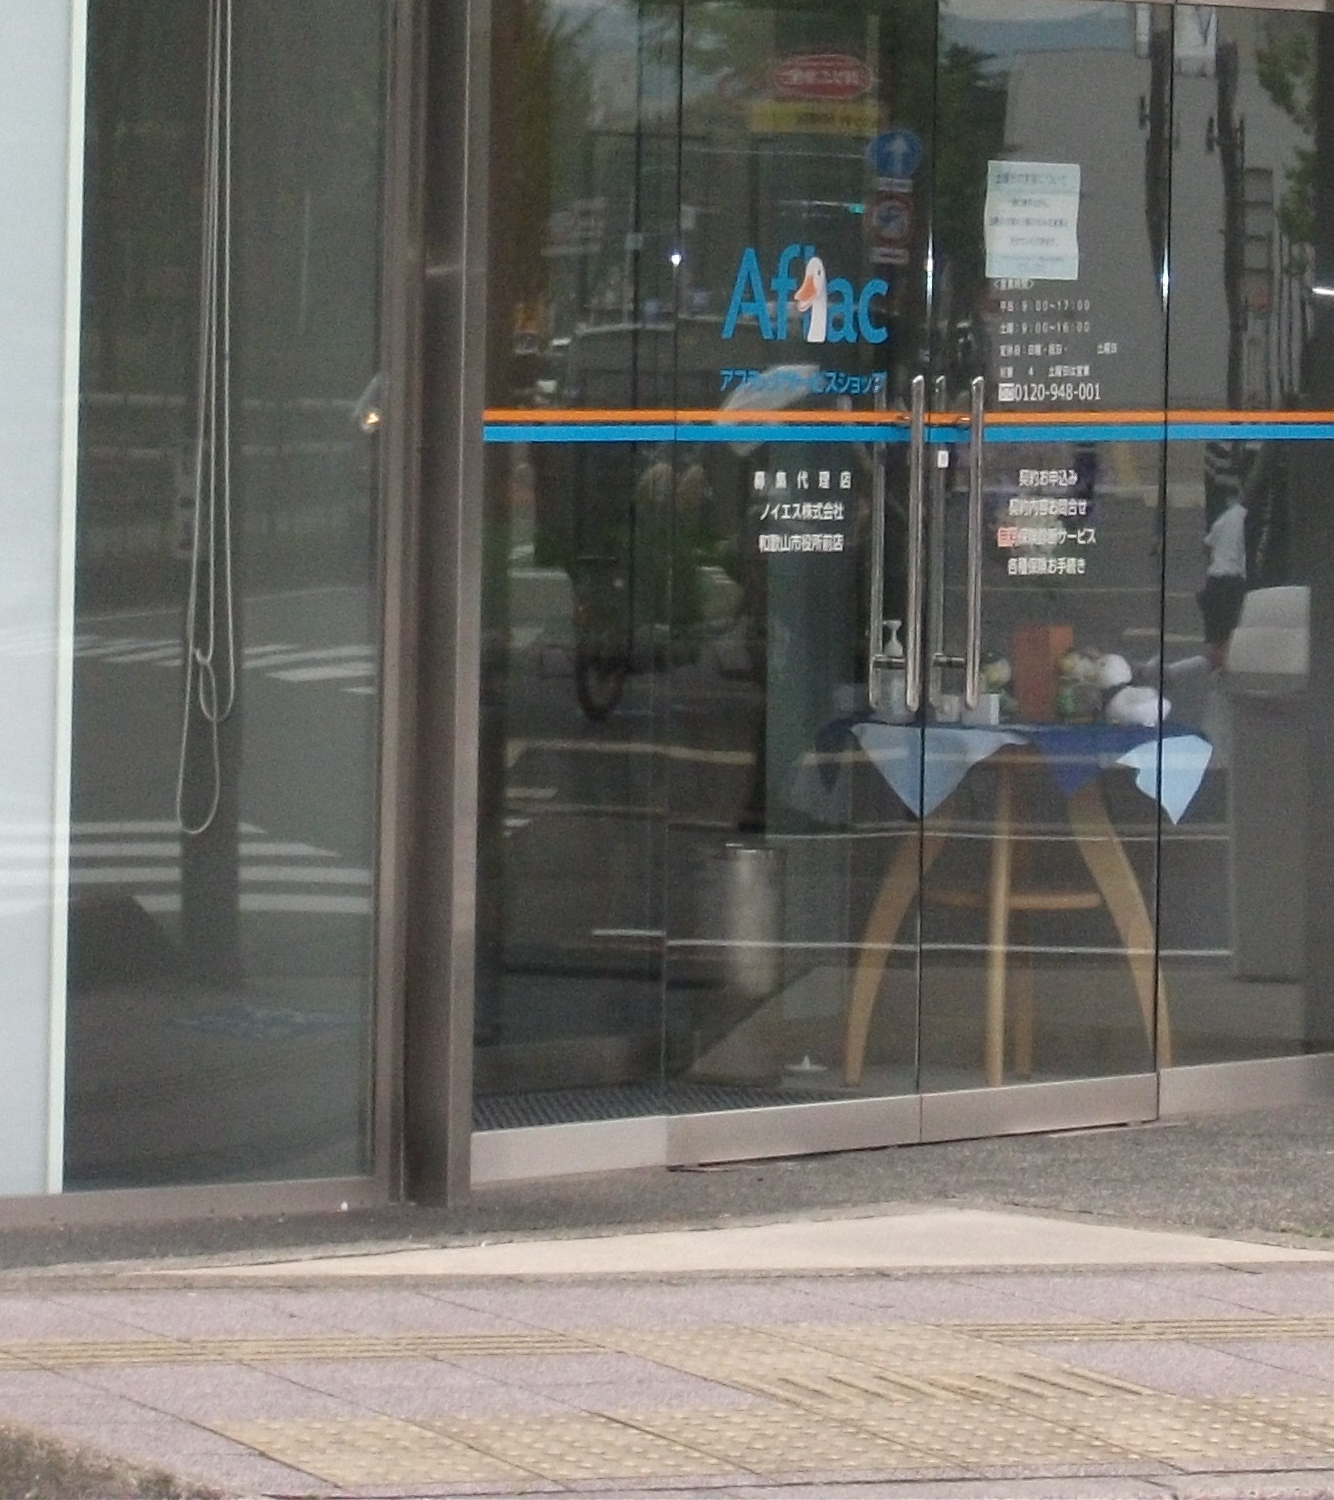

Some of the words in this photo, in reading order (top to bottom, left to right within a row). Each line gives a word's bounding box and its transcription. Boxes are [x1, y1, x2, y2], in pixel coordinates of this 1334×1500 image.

[1014, 382, 1101, 401] 0120-948-001
[759, 501, 845, 521] ノイエス株式会社
[758, 533, 845, 553] 和歌山市役所前店
